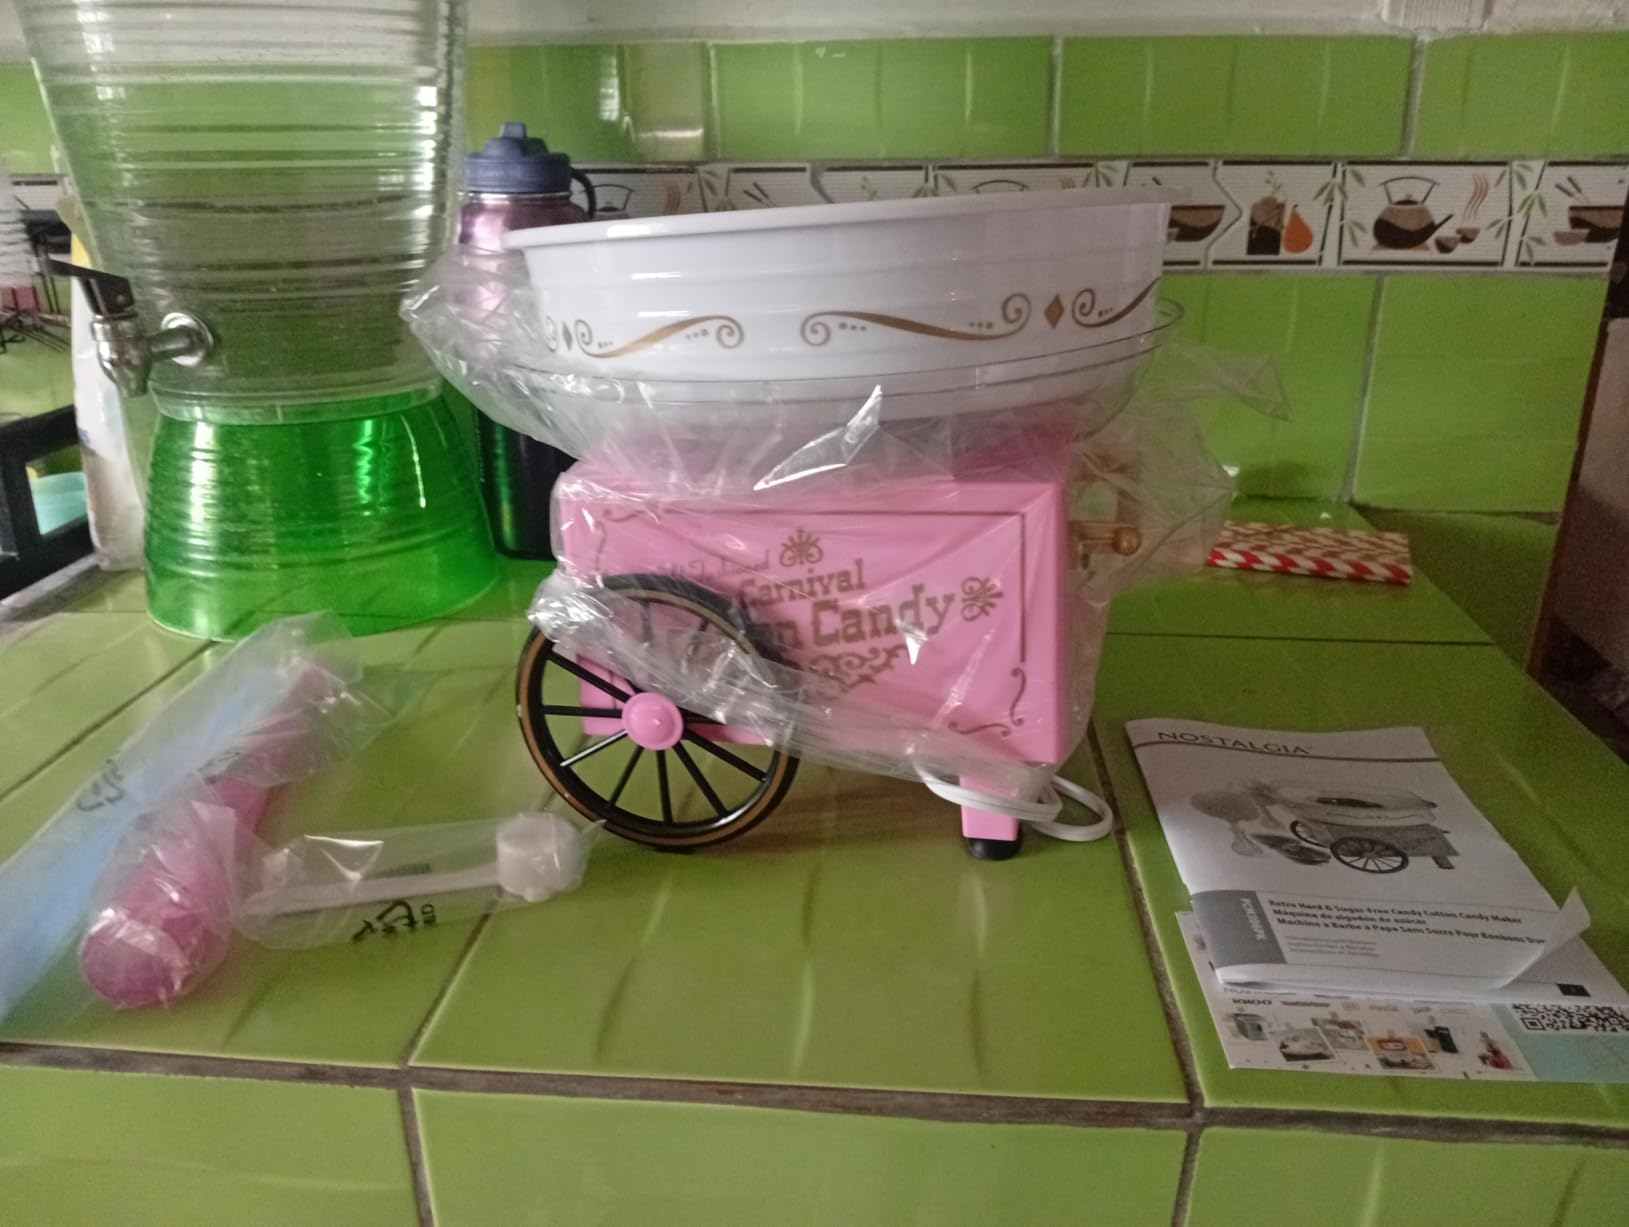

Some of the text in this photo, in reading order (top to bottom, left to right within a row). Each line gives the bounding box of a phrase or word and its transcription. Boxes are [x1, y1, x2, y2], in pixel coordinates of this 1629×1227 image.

[738, 558, 866, 608] Carnival
[811, 583, 955, 646] Candy
[1157, 731, 1310, 755] NOSTALGIA
